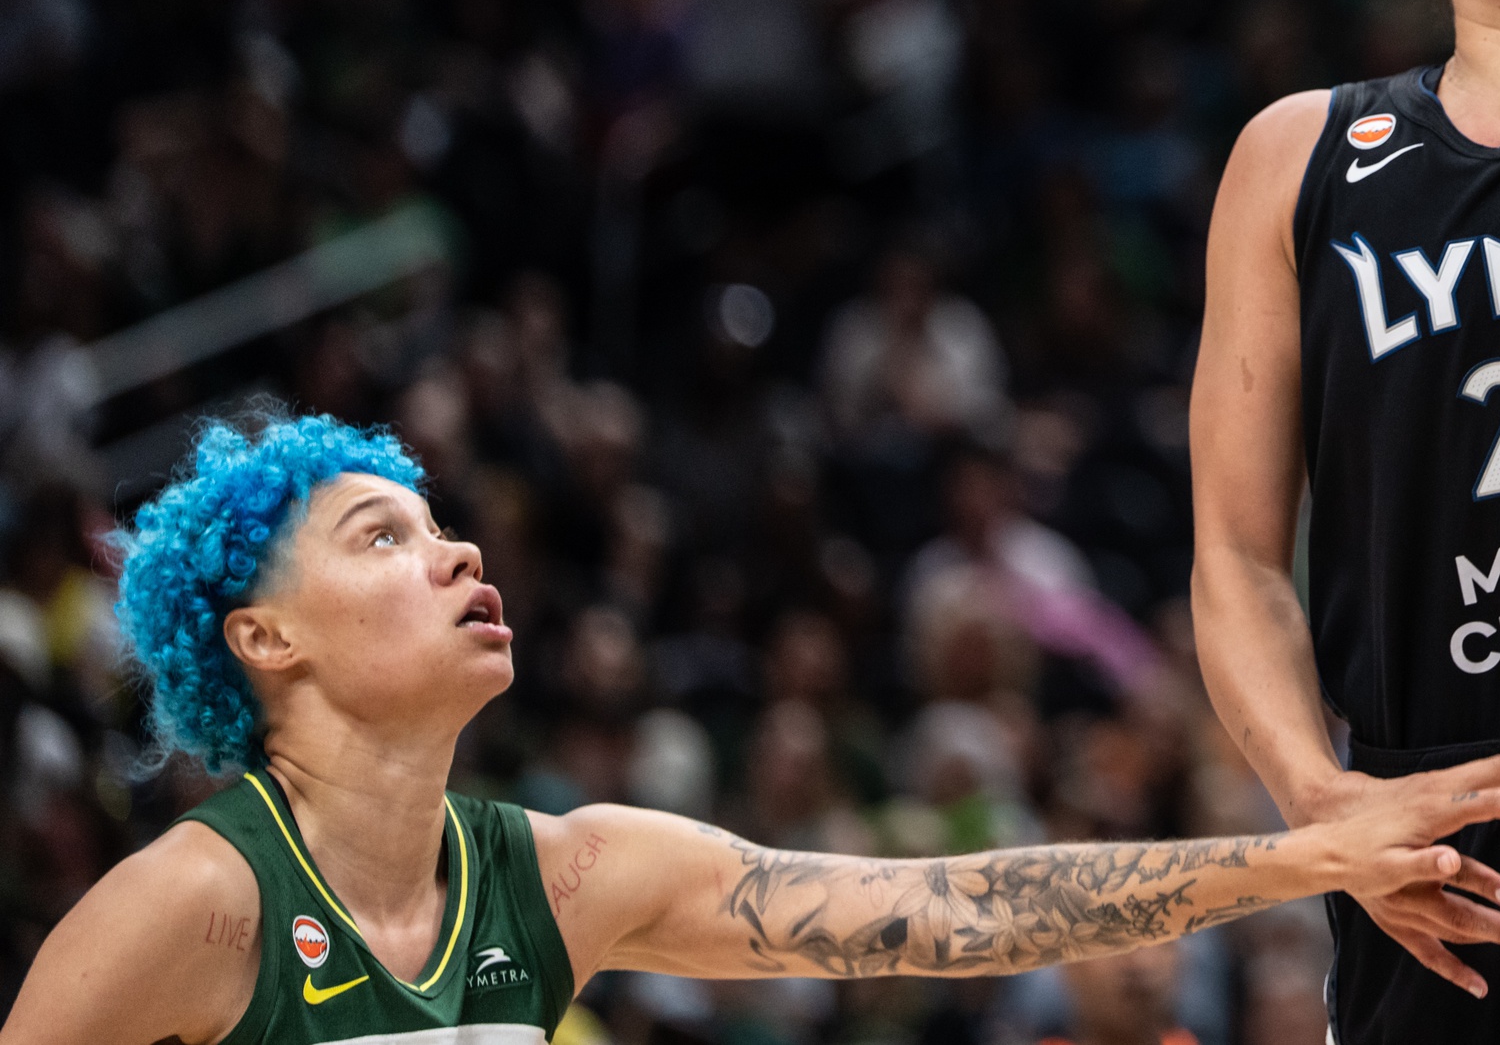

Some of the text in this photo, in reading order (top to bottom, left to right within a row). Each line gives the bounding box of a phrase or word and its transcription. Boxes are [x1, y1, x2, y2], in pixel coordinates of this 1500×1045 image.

[551, 833, 608, 919] AUGH
[205, 911, 251, 952] LIVE
[466, 968, 529, 988] YMETRA
